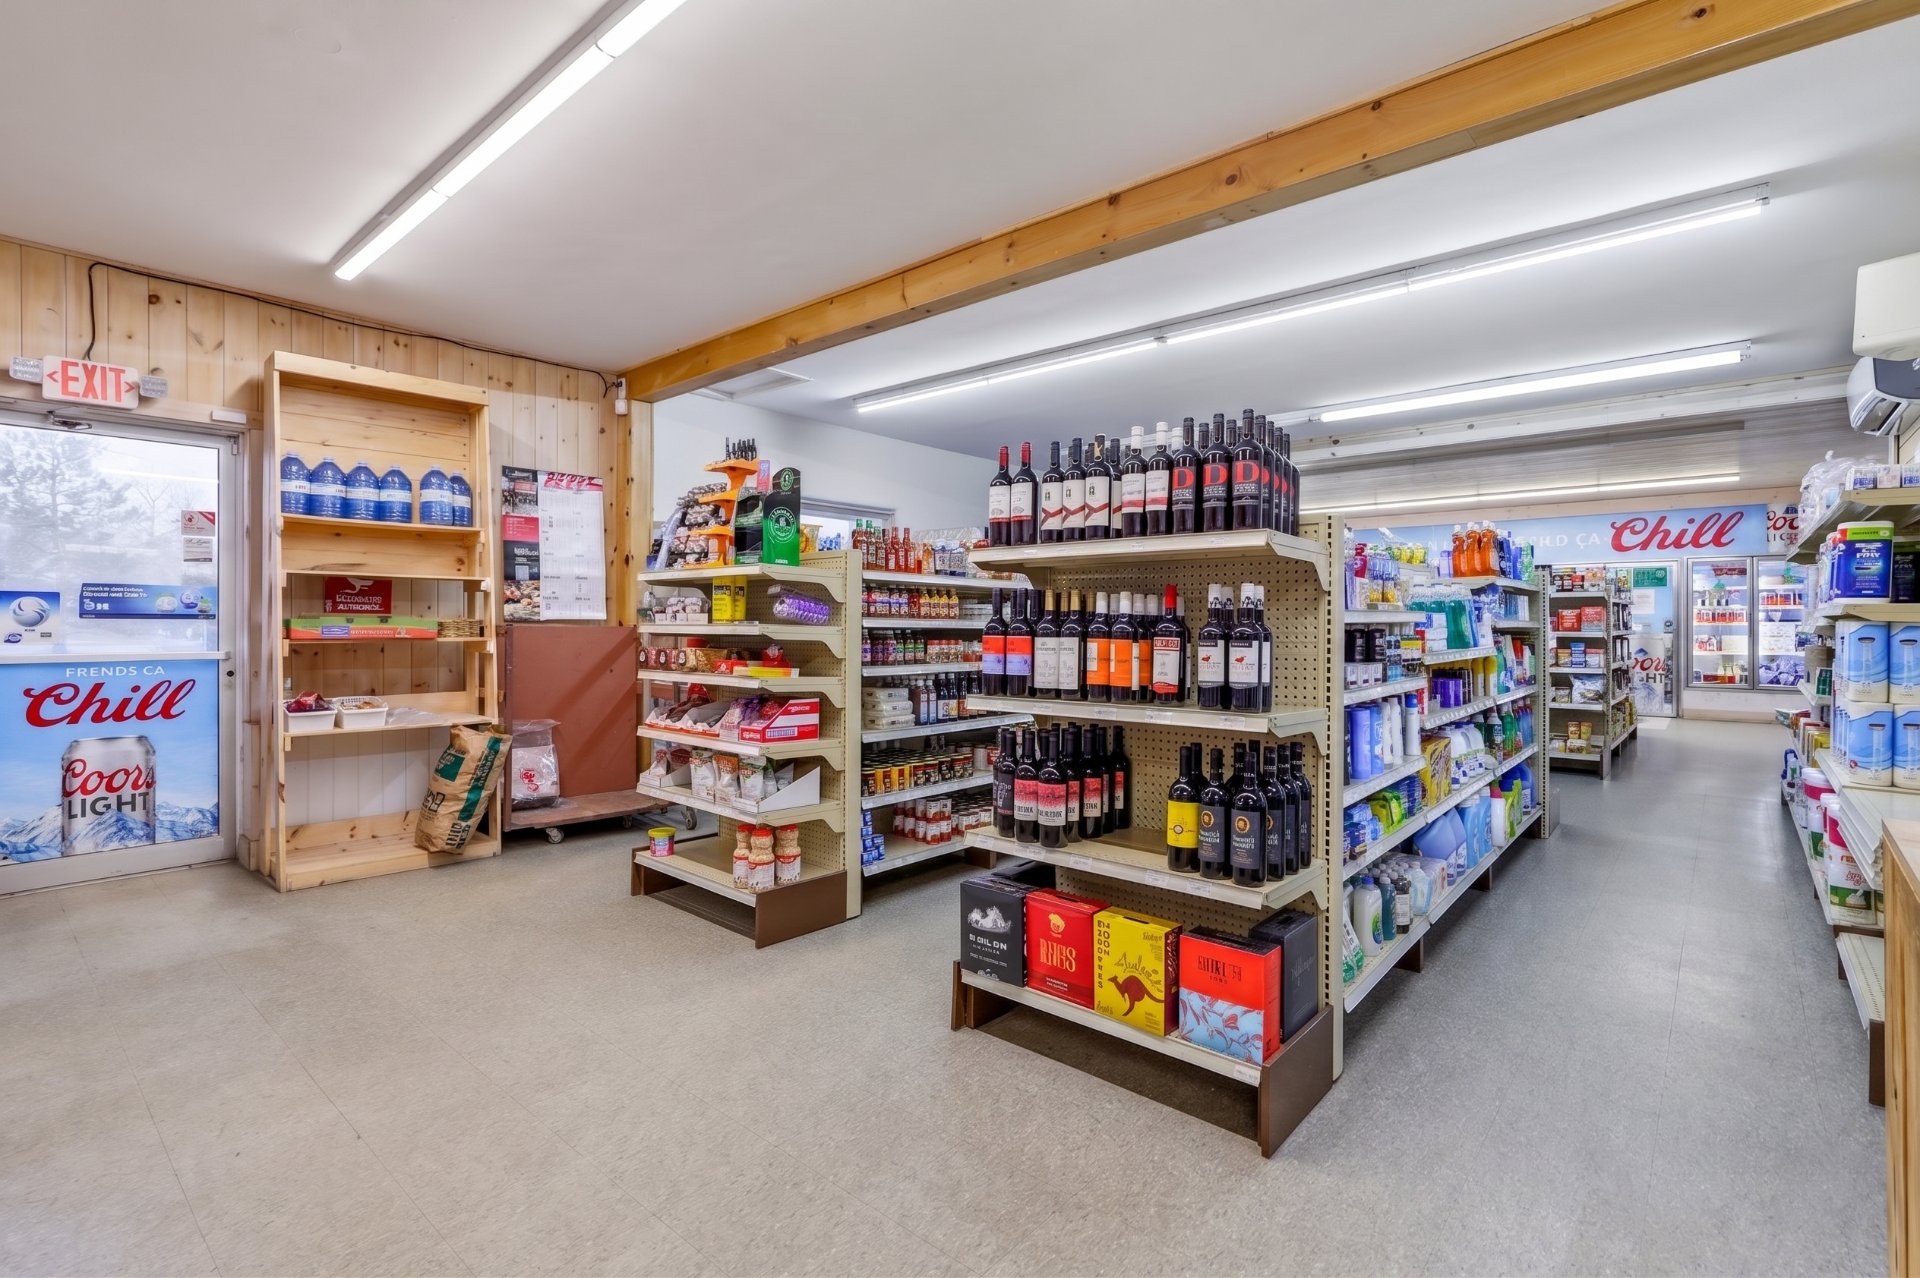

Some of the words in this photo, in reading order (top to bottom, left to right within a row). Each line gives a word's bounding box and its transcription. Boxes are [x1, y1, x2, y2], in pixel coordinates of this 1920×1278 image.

[60, 360, 126, 402] EXIT
[1610, 511, 1744, 552] Chill
[65, 666, 138, 678] FRENDS
[143, 665, 165, 677] CA
[23, 679, 196, 728] Chill
[62, 758, 157, 799] Coors
[67, 791, 150, 820] LIGHT
